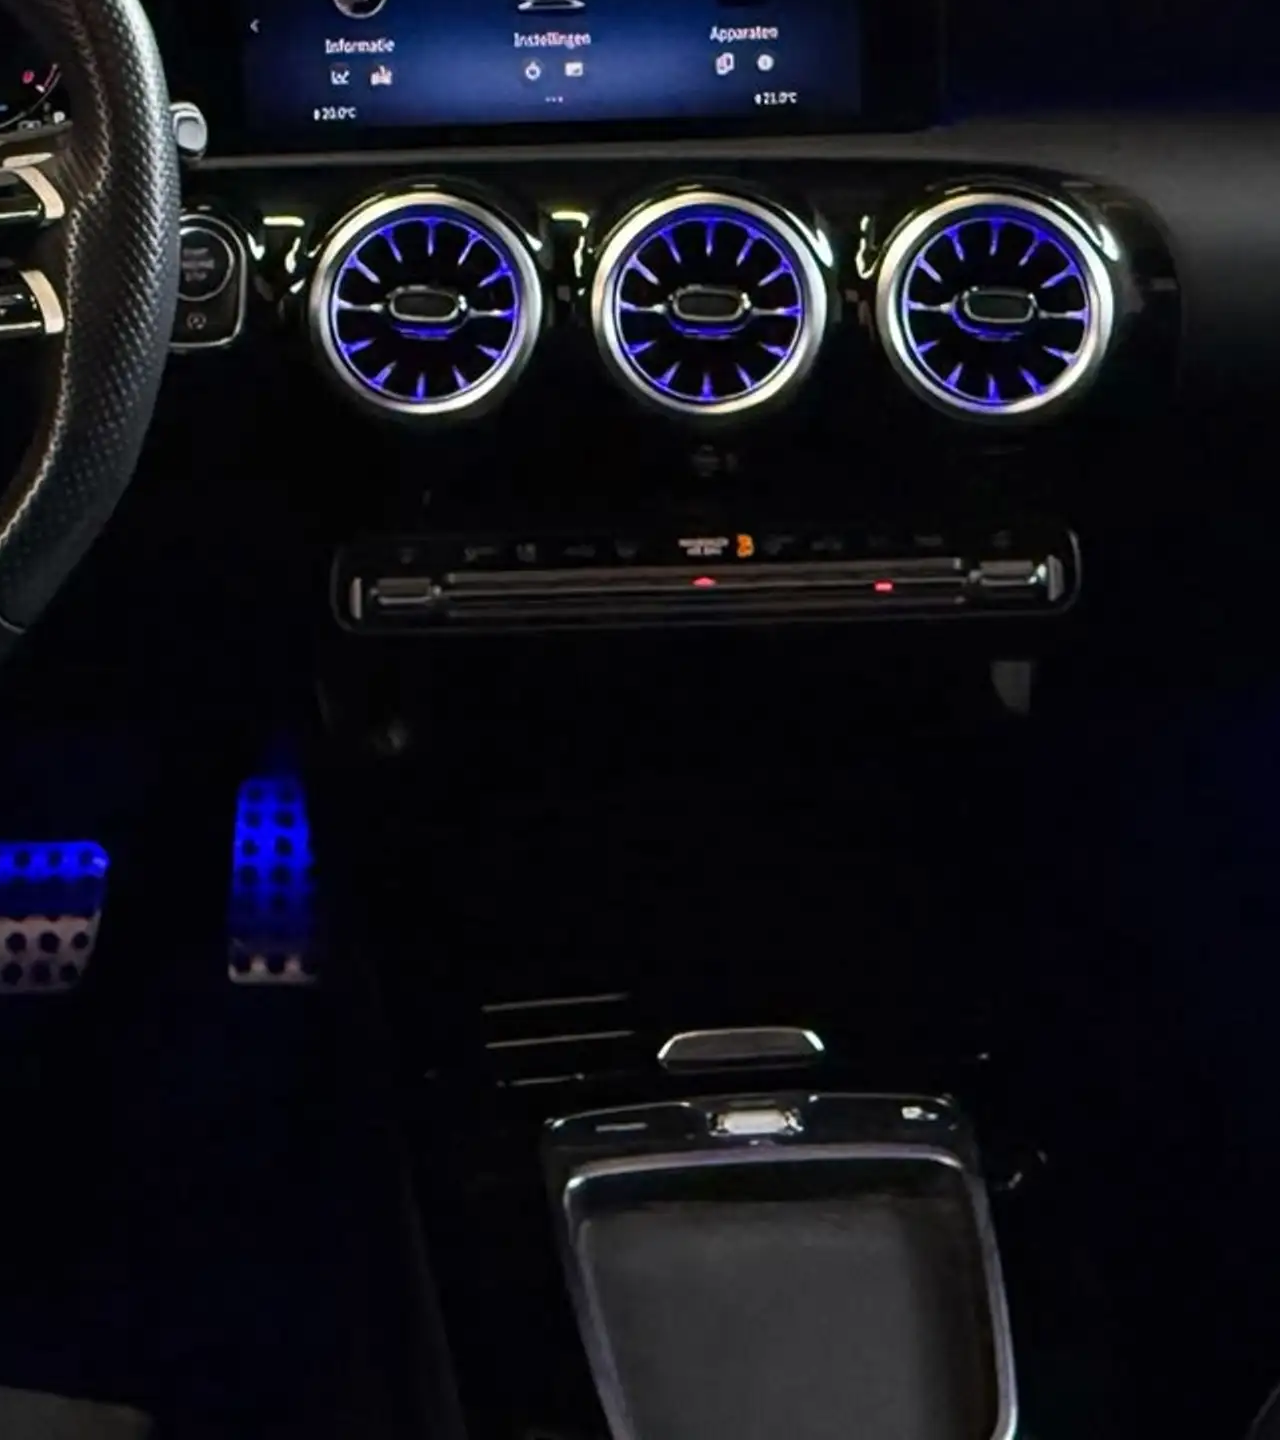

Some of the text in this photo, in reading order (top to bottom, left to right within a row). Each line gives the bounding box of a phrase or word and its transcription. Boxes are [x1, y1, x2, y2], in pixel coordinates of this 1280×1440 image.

[513, 32, 592, 49] Instellingen
[709, 26, 779, 42] Apparaten
[325, 37, 395, 53] Informatie
